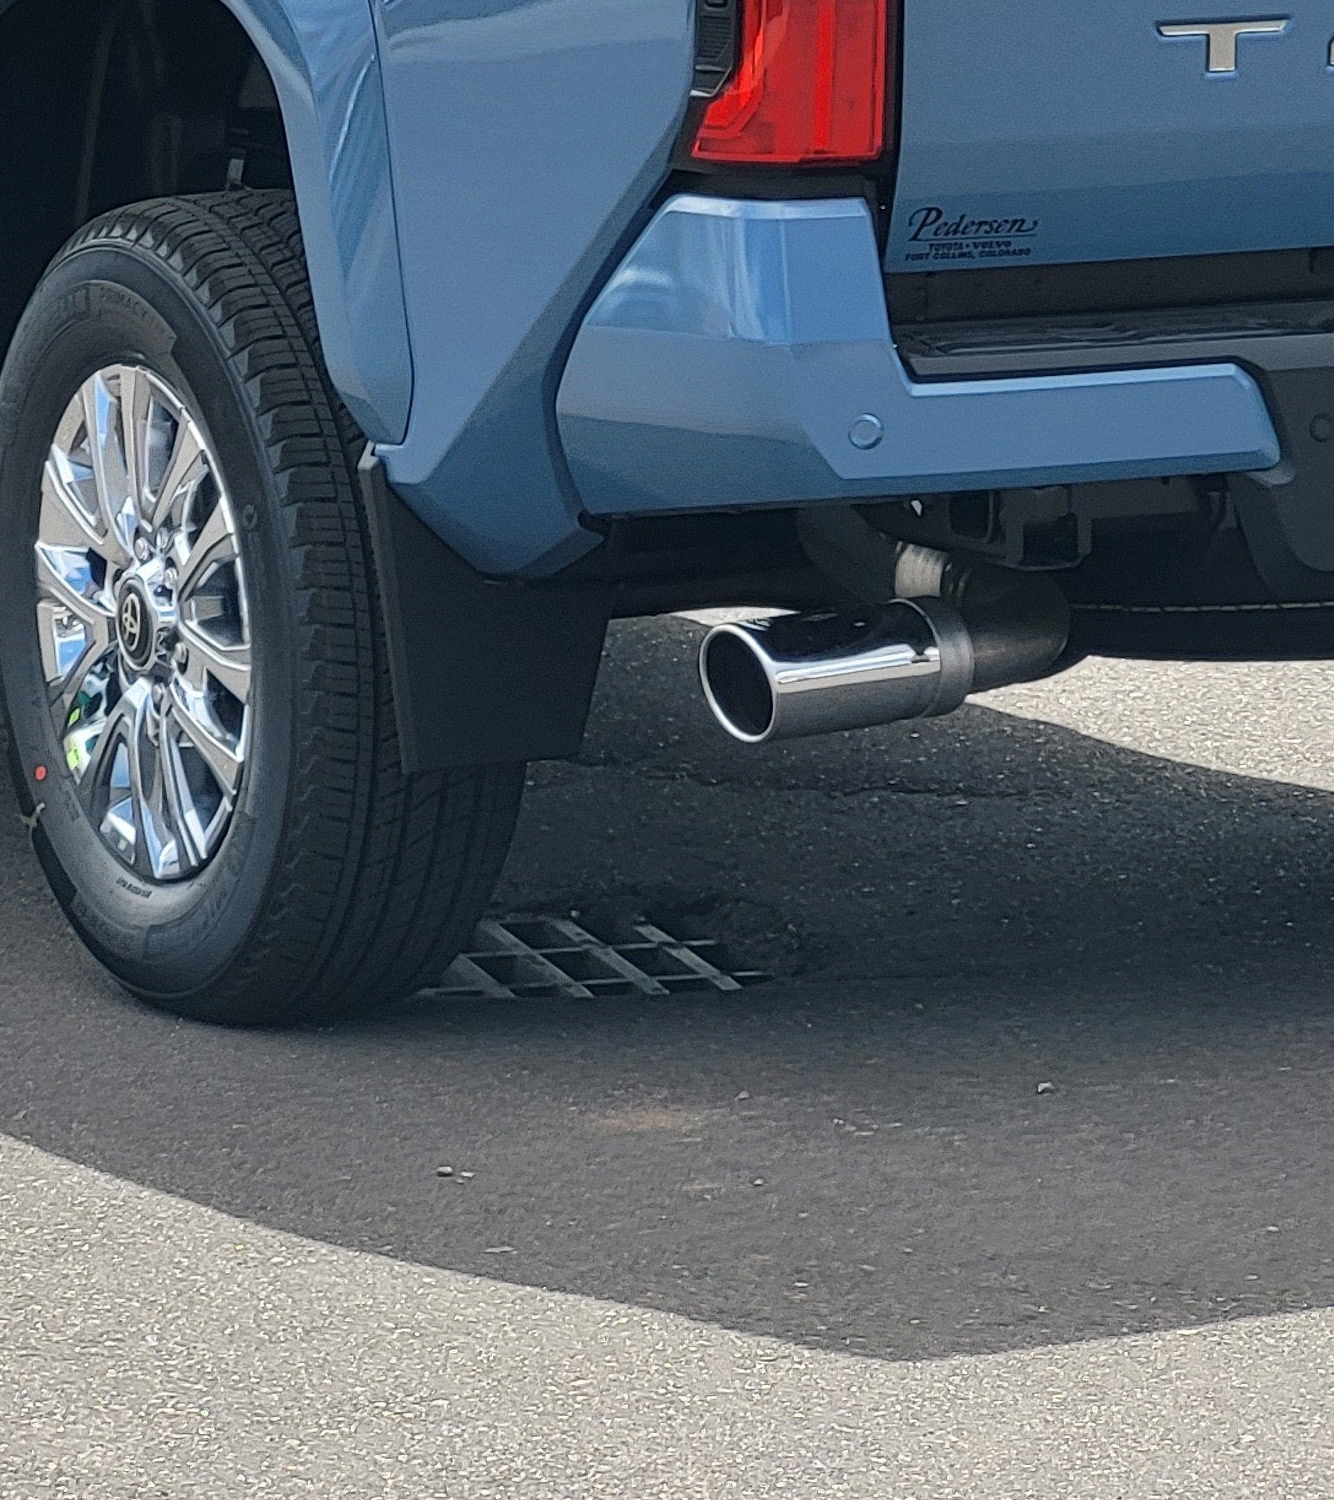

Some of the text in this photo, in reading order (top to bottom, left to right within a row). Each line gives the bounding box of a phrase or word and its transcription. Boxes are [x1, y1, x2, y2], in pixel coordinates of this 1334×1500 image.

[908, 206, 1039, 242] Pedersen
[929, 240, 1012, 252] TOYOTA VOLVO
